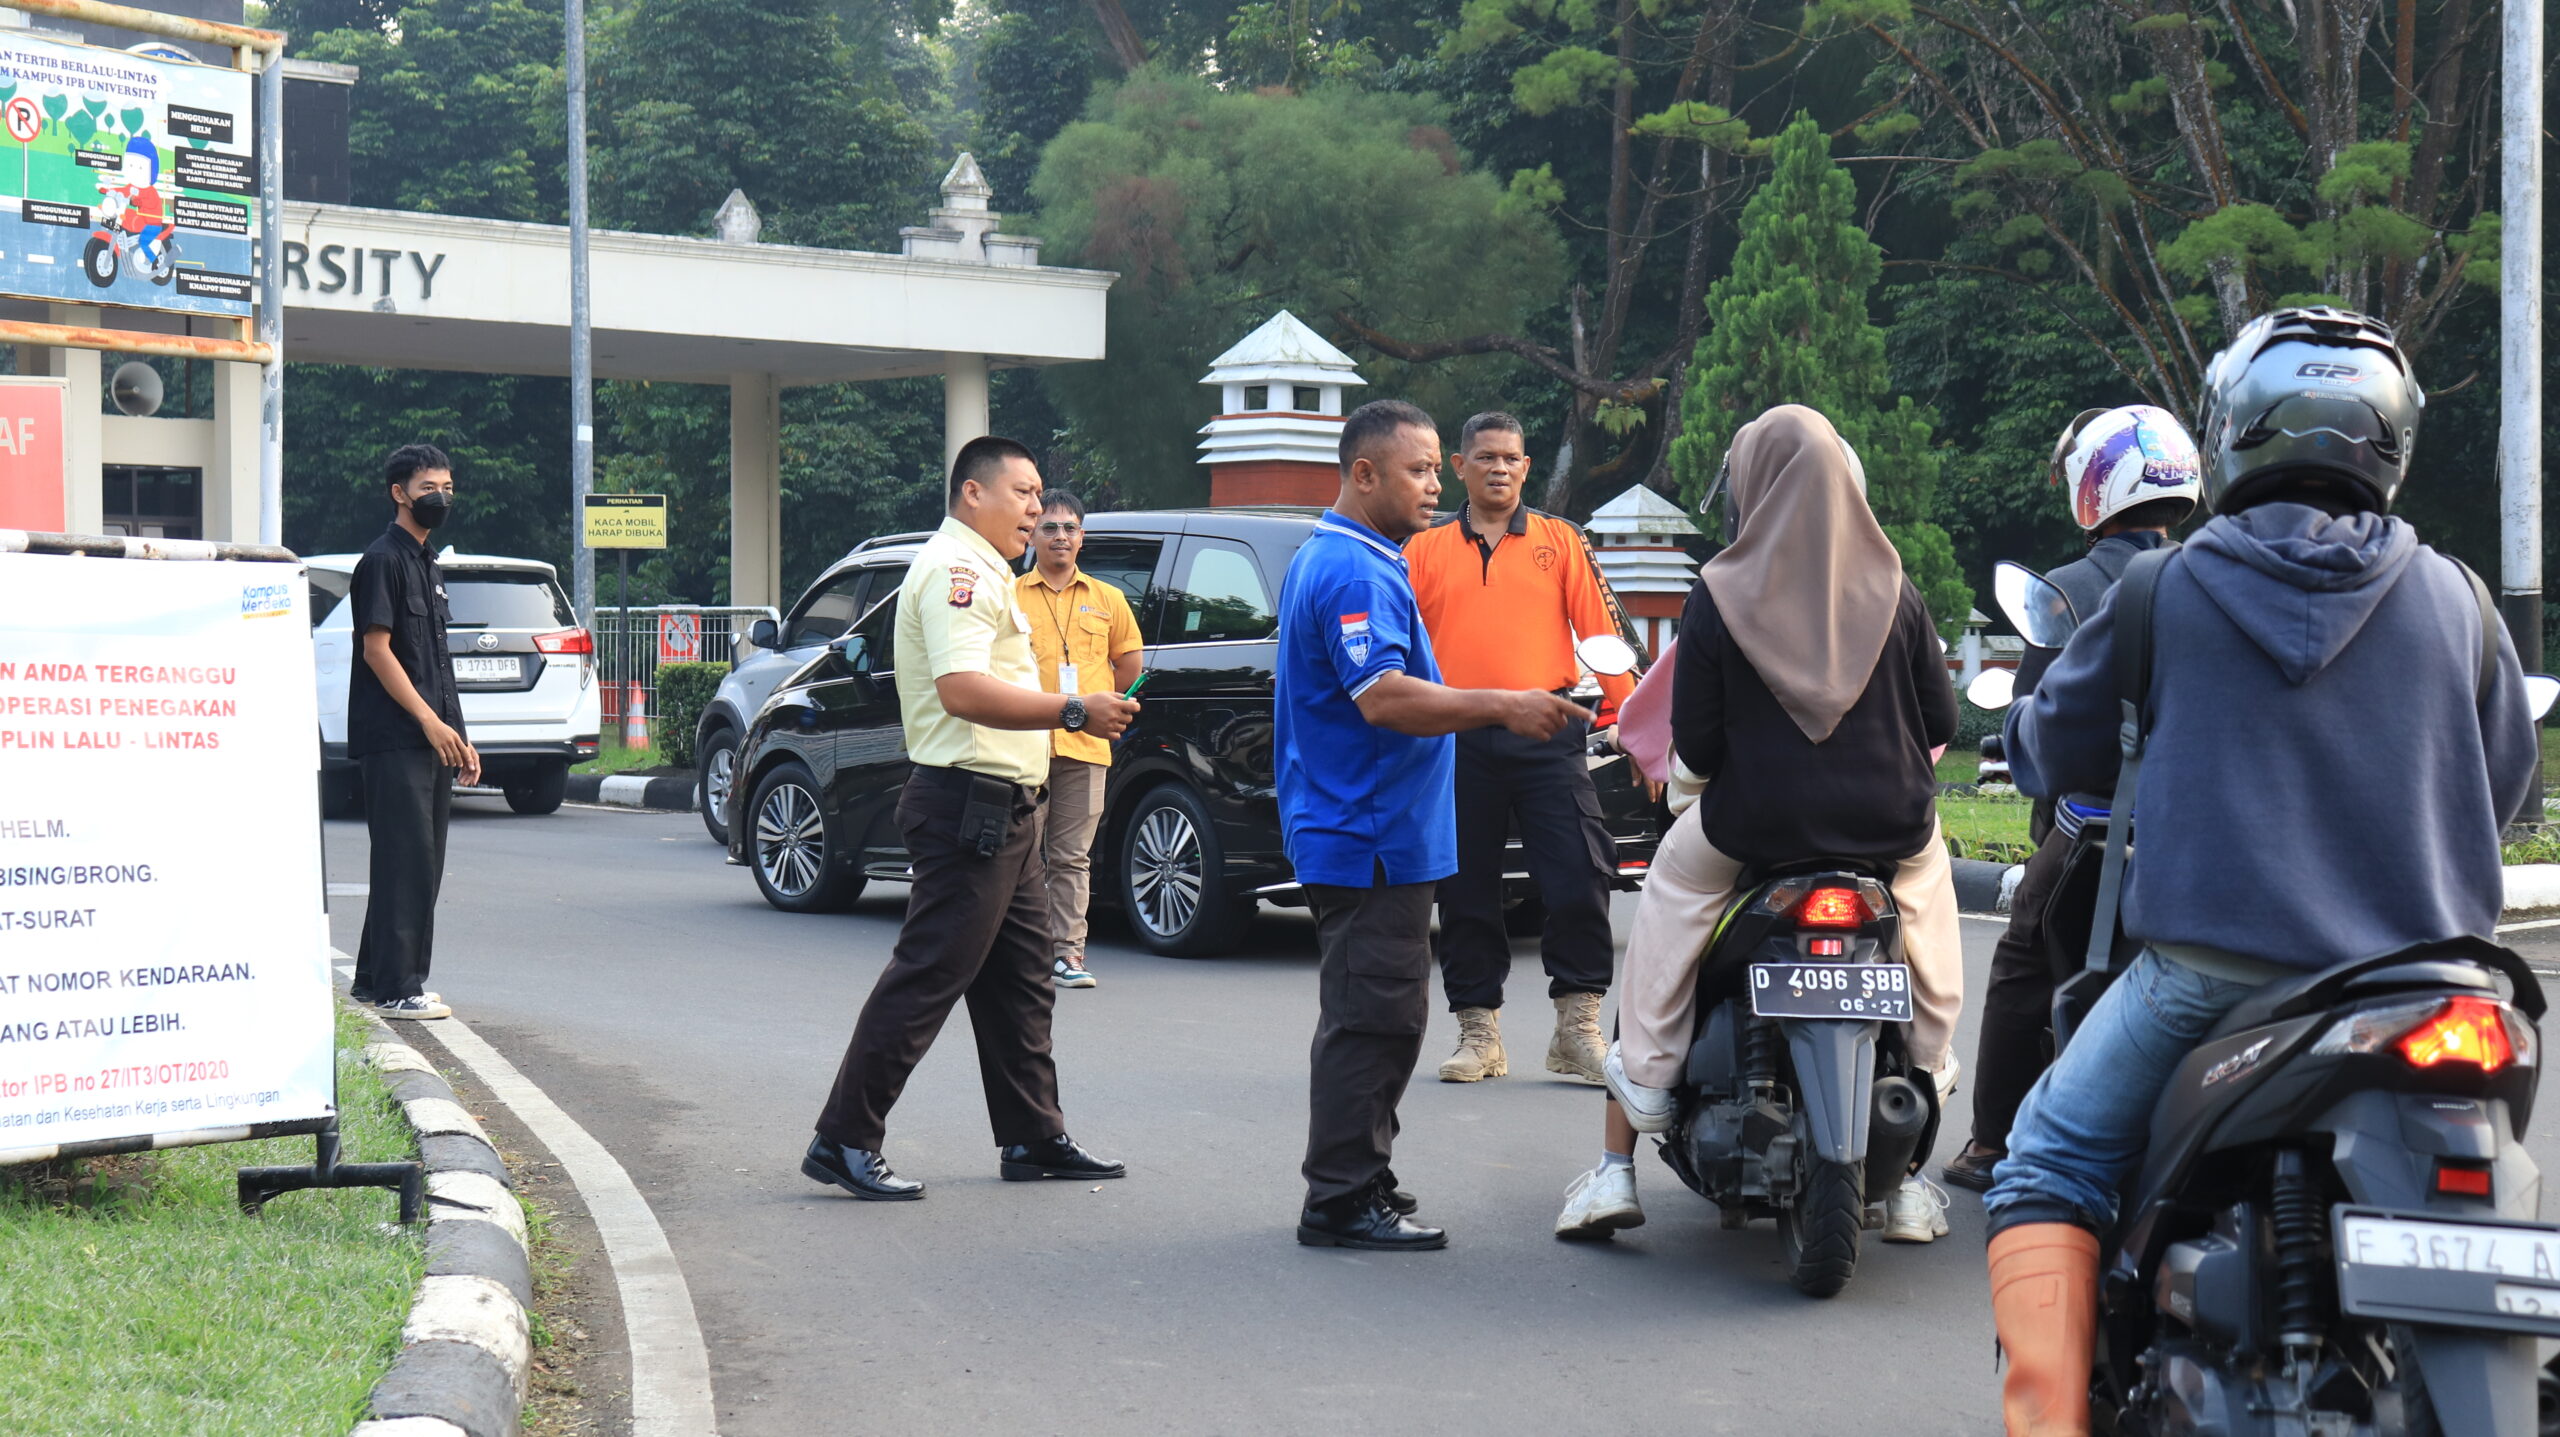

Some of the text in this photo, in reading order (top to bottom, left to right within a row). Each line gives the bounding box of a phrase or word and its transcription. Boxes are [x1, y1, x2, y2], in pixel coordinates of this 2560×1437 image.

[15, 52, 58, 68] TERTIB
[61, 60, 157, 85] BERLALU-LINTAS
[13, 67, 63, 85] KAMPUS
[66, 76, 85, 89] IPB
[88, 80, 157, 100] UNIVERSITY
[171, 110, 231, 128] MENGGUNAKAN
[190, 124, 212, 135] HELM
[31, 204, 82, 217] MENGGUNAKAN
[178, 200, 208, 210] SELURUH
[176, 208, 247, 224] WAJIB MENGGUNAKAN
[177, 218, 200, 226] KARTU
[222, 223, 246, 232] MASUK
[180, 273, 251, 287] TIDAK MENGGUNAKAN
[189, 282, 219, 292] KNALPOT
[594, 518, 656, 526] KACA MOBIL
[587, 529, 663, 537] HARAP DIBUKA
[951, 567, 977, 580] POLDA
[242, 584, 288, 601] Kampus
[241, 597, 291, 613] Merdeka
[24, 663, 88, 682] ANDA
[95, 664, 236, 685] TERGANGGU
[456, 659, 517, 672] B 1731 DFB
[100, 698, 236, 717] PENEGAKAN
[63, 731, 121, 749] LALU
[144, 731, 220, 749] LINTAS
[1, 819, 70, 838] HELM.
[0, 908, 96, 930] T-SURAT
[28, 971, 112, 993] NOMOR
[120, 962, 255, 988] KENDARAAN.
[1756, 968, 1904, 991] D 4096 SBB
[0, 1012, 186, 1044] ANG ATAU LEBIH.
[0, 1060, 229, 1098] tor IPB no 27/IT3/OT/2020
[0, 1090, 280, 1128] atan dan Kesehatan Kerja serta Lingkungan
[2356, 1229, 2373, 1263] F
[2400, 1232, 2504, 1274] 3674
